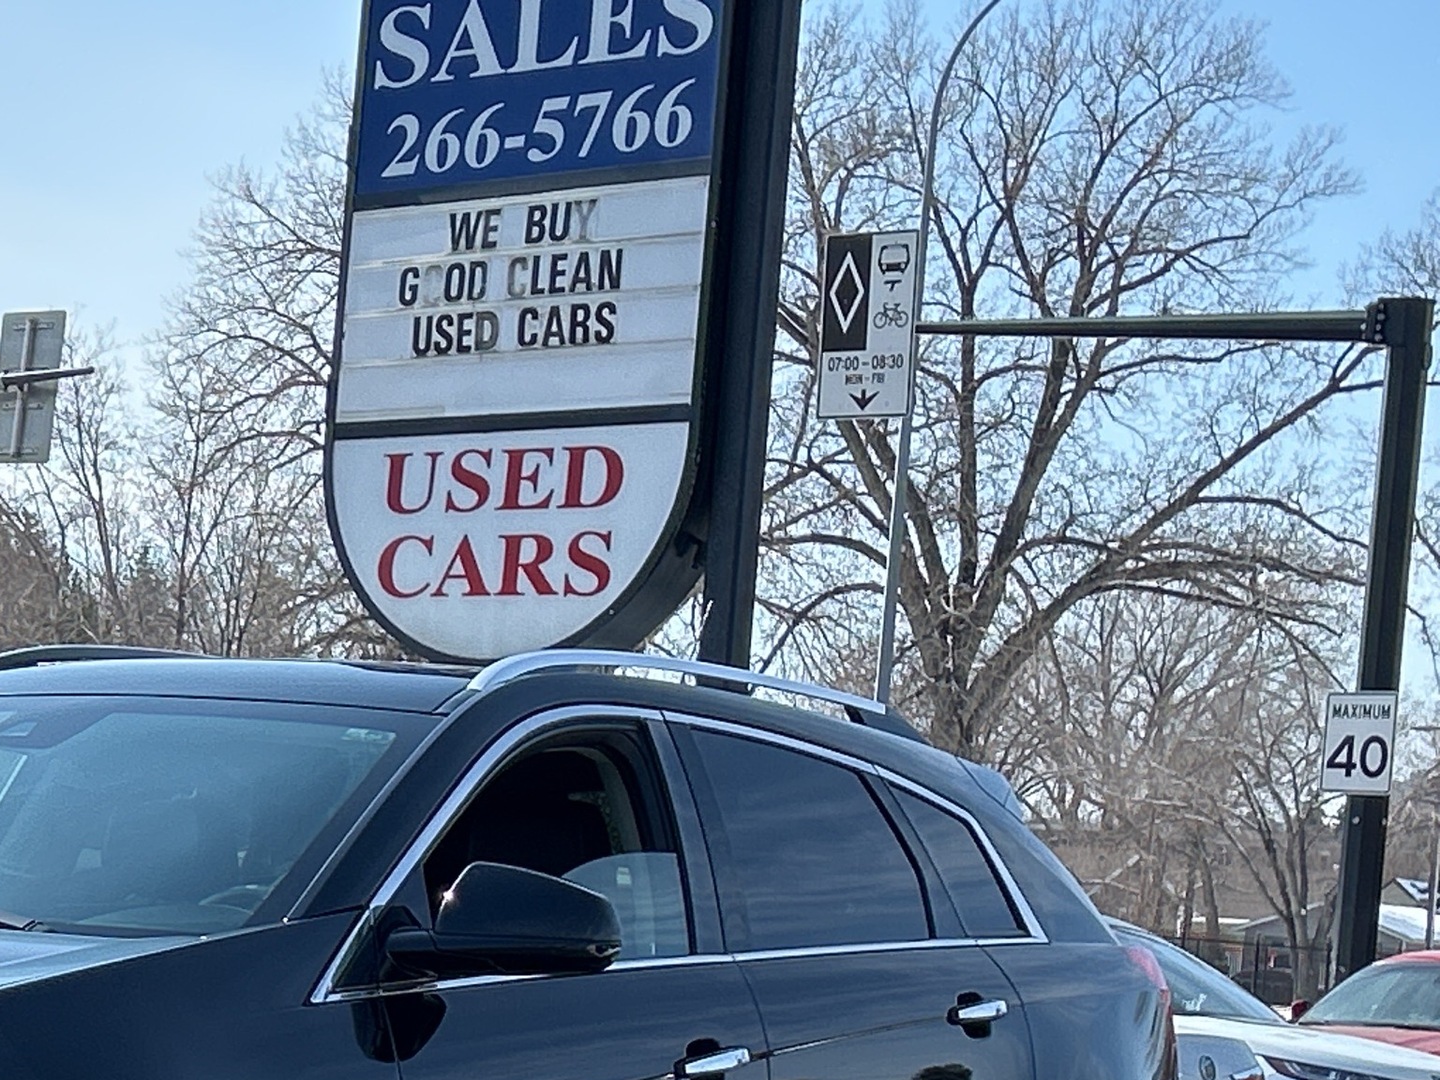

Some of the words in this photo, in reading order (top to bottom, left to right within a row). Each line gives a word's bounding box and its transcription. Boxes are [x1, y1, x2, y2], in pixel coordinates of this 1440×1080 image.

[373, 0, 714, 91] SALES
[381, 78, 696, 178] 266-5766
[449, 208, 502, 251] WE
[524, 199, 598, 244] BUY
[507, 249, 624, 297] CLEAN
[412, 311, 500, 357] USED
[517, 301, 618, 348] CARS
[828, 356, 859, 371] 07:00
[872, 354, 904, 369] 08:30
[384, 445, 625, 514] USED
[376, 531, 613, 598] CARS
[1332, 703, 1392, 719] MAXIMUM
[1326, 735, 1388, 778] 40
